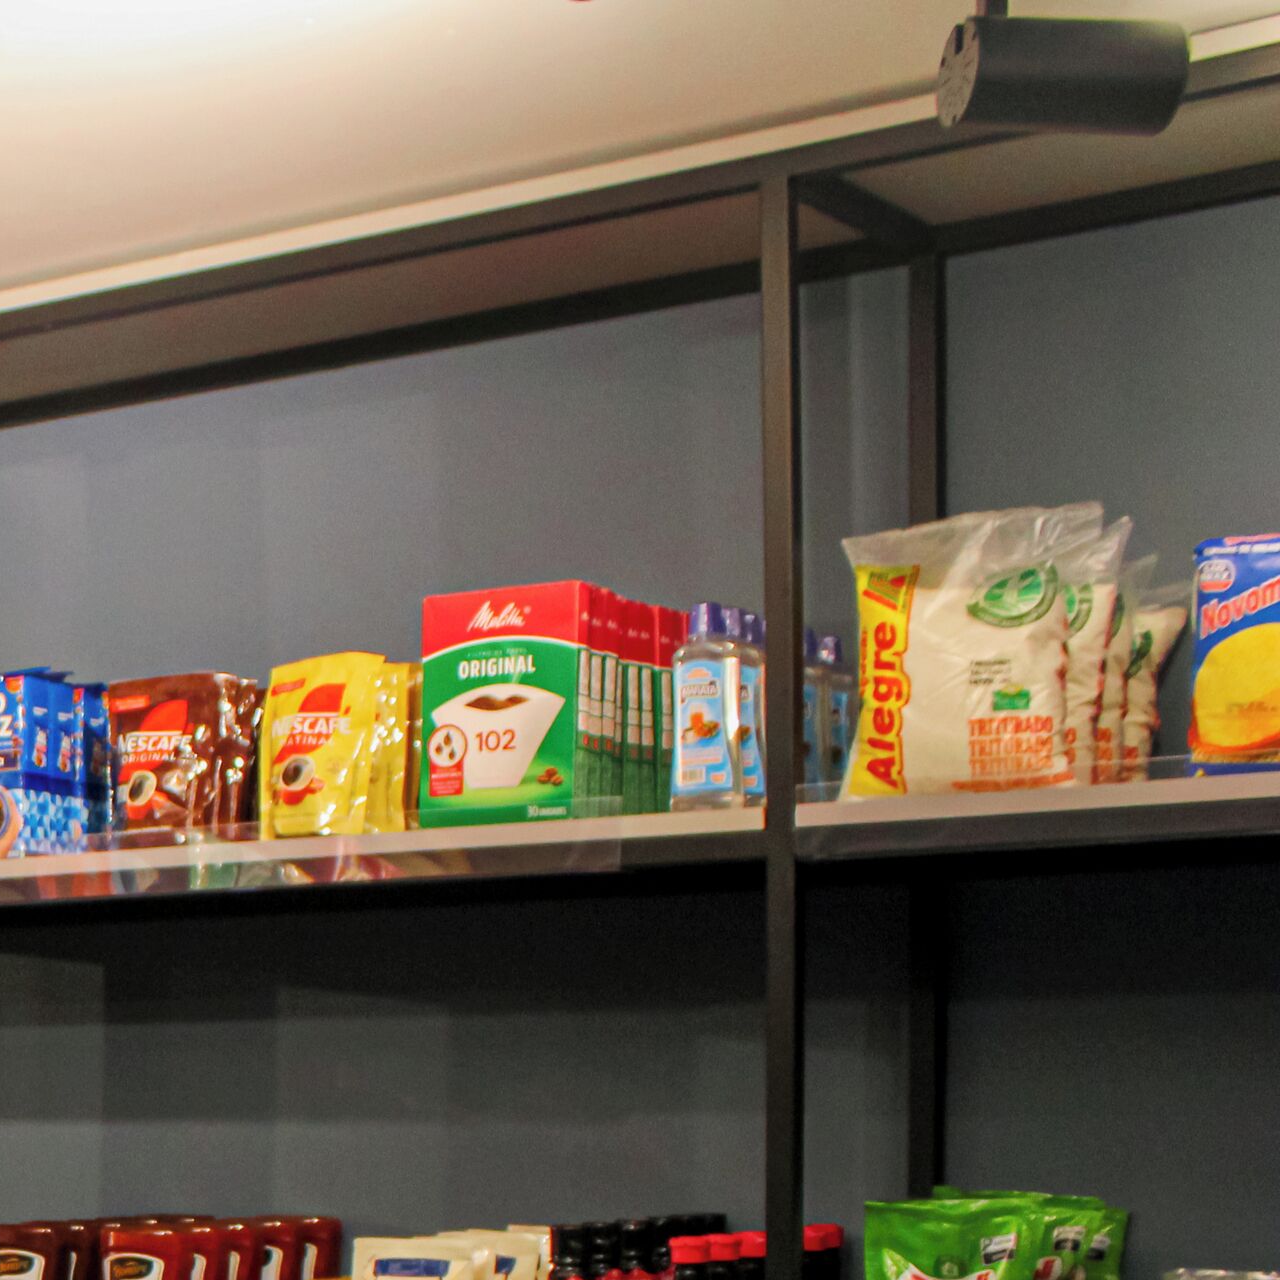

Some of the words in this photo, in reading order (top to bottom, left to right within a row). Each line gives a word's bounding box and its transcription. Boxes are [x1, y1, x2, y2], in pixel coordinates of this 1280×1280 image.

[467, 601, 526, 632] Melitta
[458, 654, 536, 679] ORIGINAL
[866, 620, 903, 790] Alegre
[475, 729, 516, 753] 102
